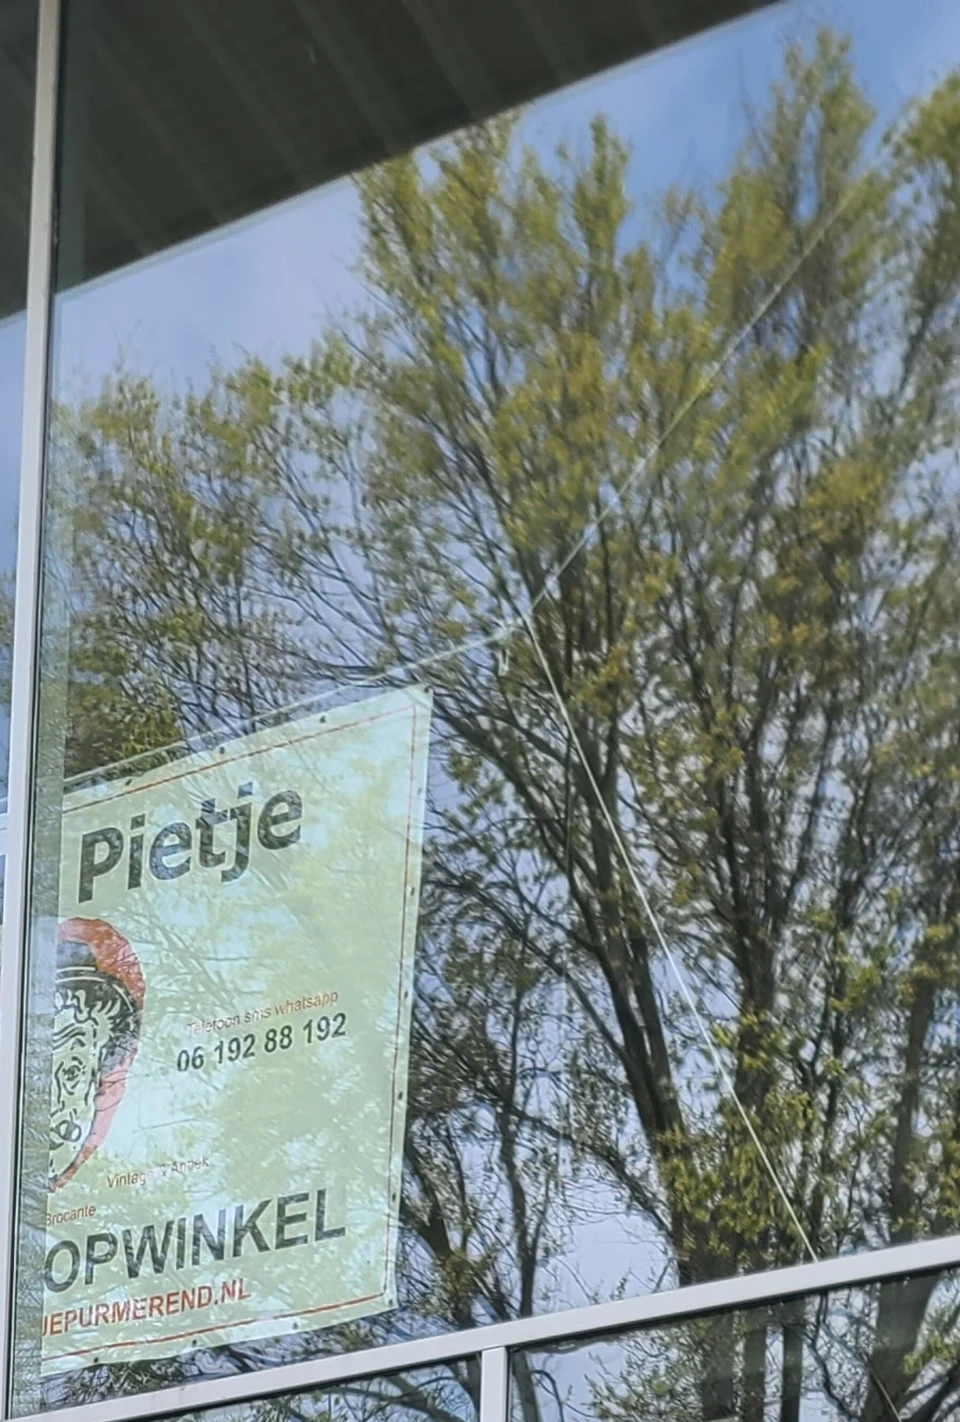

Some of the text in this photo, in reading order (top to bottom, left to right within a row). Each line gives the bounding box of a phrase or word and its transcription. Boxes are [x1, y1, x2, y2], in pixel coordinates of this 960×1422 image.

[77, 782, 304, 904] Pietje
[274, 990, 339, 1016] whatsapp
[177, 1012, 347, 1073] 06 192 88 192
